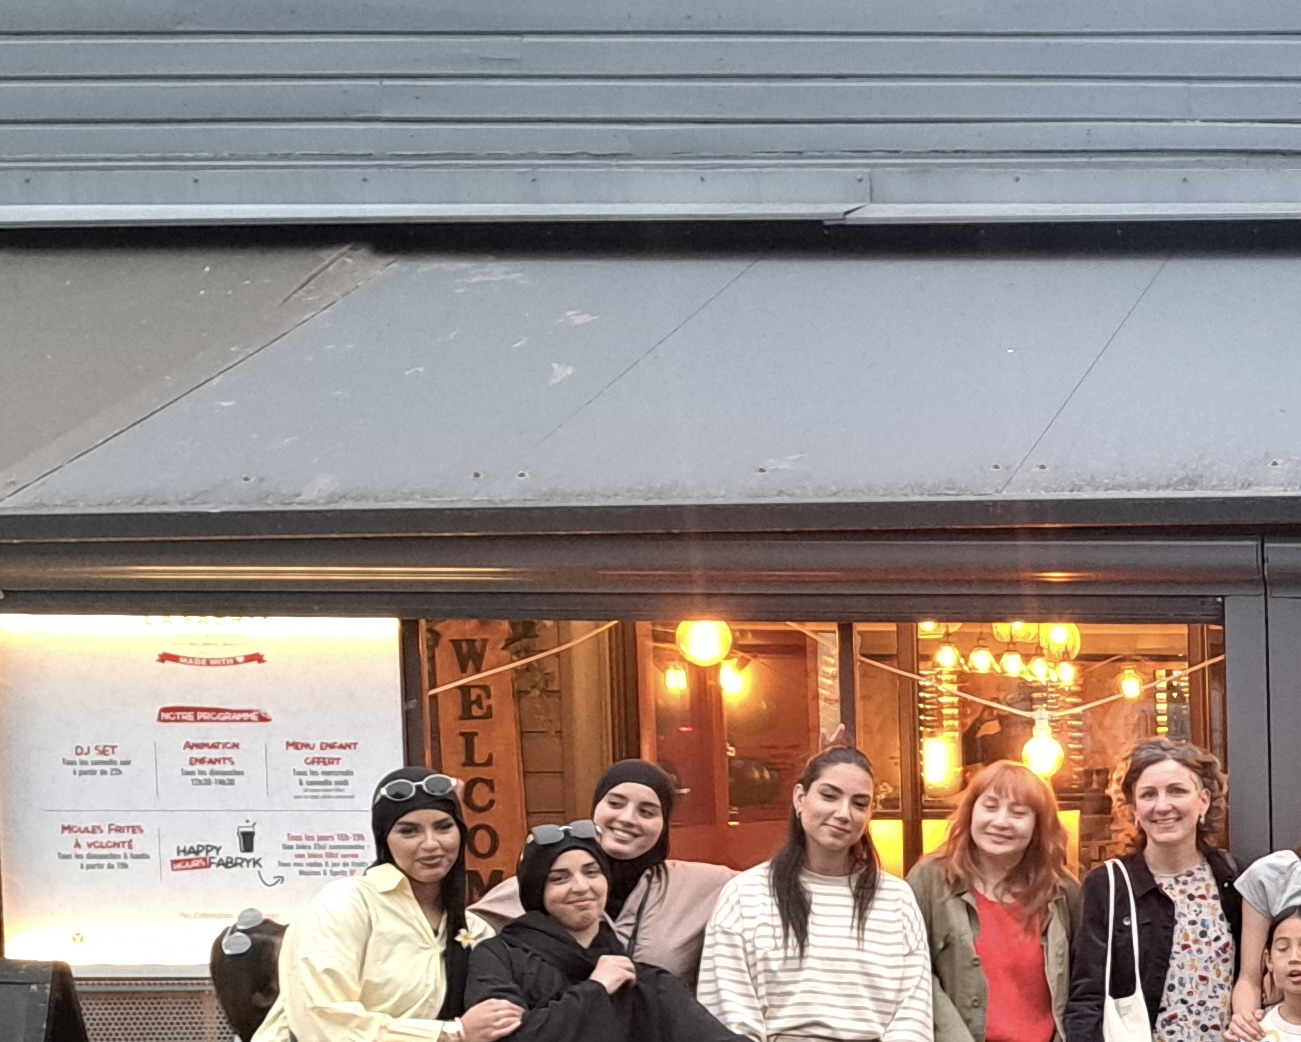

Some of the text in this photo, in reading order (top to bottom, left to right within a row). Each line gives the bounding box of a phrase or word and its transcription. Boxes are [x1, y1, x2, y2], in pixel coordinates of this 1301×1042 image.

[179, 656, 207, 665] MADE
[160, 711, 259, 721] NOTRE PROGRAMME
[74, 744, 119, 756] DJ SET
[182, 740, 240, 750] ANIMATION
[285, 740, 359, 751] MENU ENFANT
[188, 756, 235, 766] ENFANTS
[303, 756, 342, 766] OFFERT
[61, 823, 144, 834] MOULES FRITES
[73, 838, 134, 850] À VOLONTÉ
[176, 844, 222, 856] HAPPY
[208, 856, 263, 869] FABRYK
